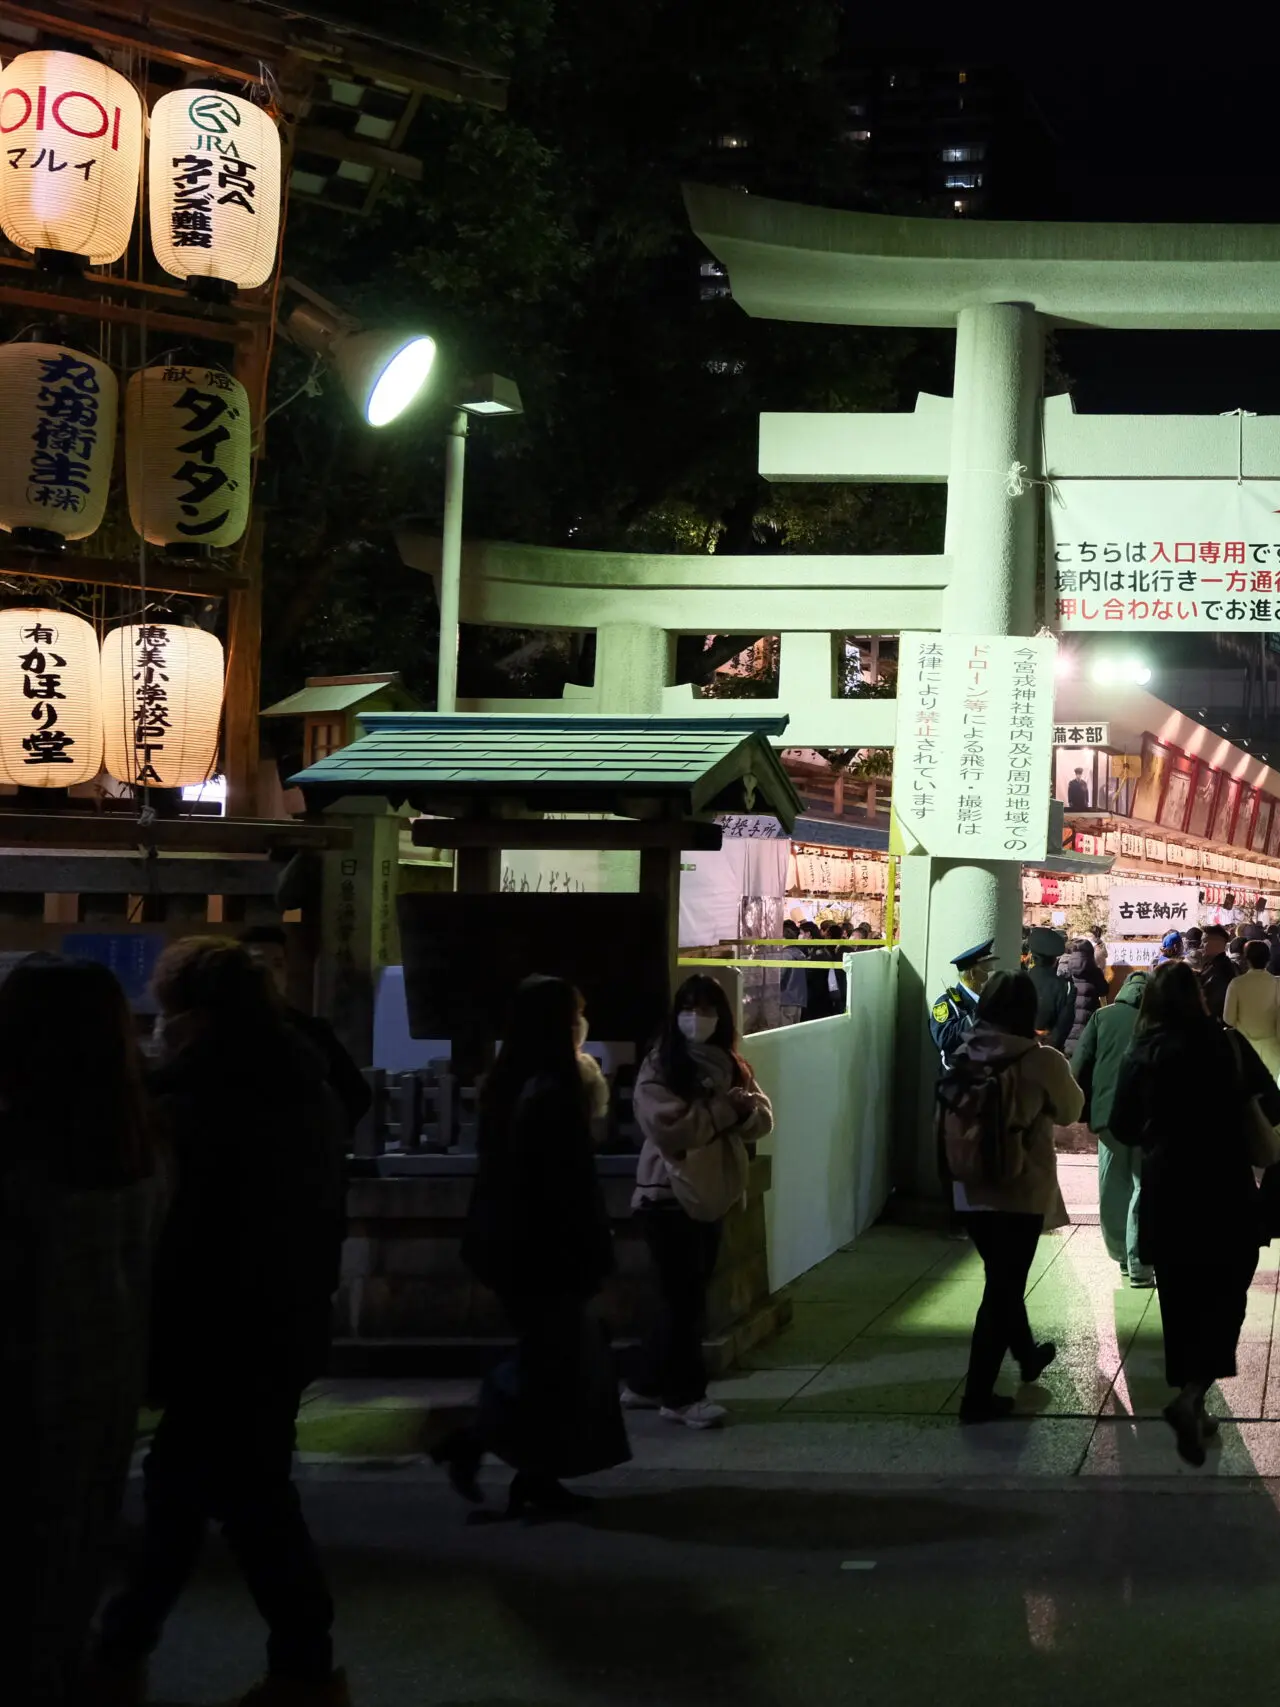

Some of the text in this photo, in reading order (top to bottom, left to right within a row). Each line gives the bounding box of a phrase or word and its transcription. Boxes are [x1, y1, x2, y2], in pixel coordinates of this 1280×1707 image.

[7, 148, 97, 181] マルイ
[190, 135, 240, 159] JRA
[217, 156, 257, 214] JRA
[171, 387, 241, 536] ダイダン
[909, 642, 944, 820] 法律により禁止されています
[956, 644, 991, 836] ドローン等による飛行・撮影は
[1003, 646, 1039, 852] 今宮戎神社境内及び周辺地域での
[1118, 901, 1189, 920] 古笹納所
